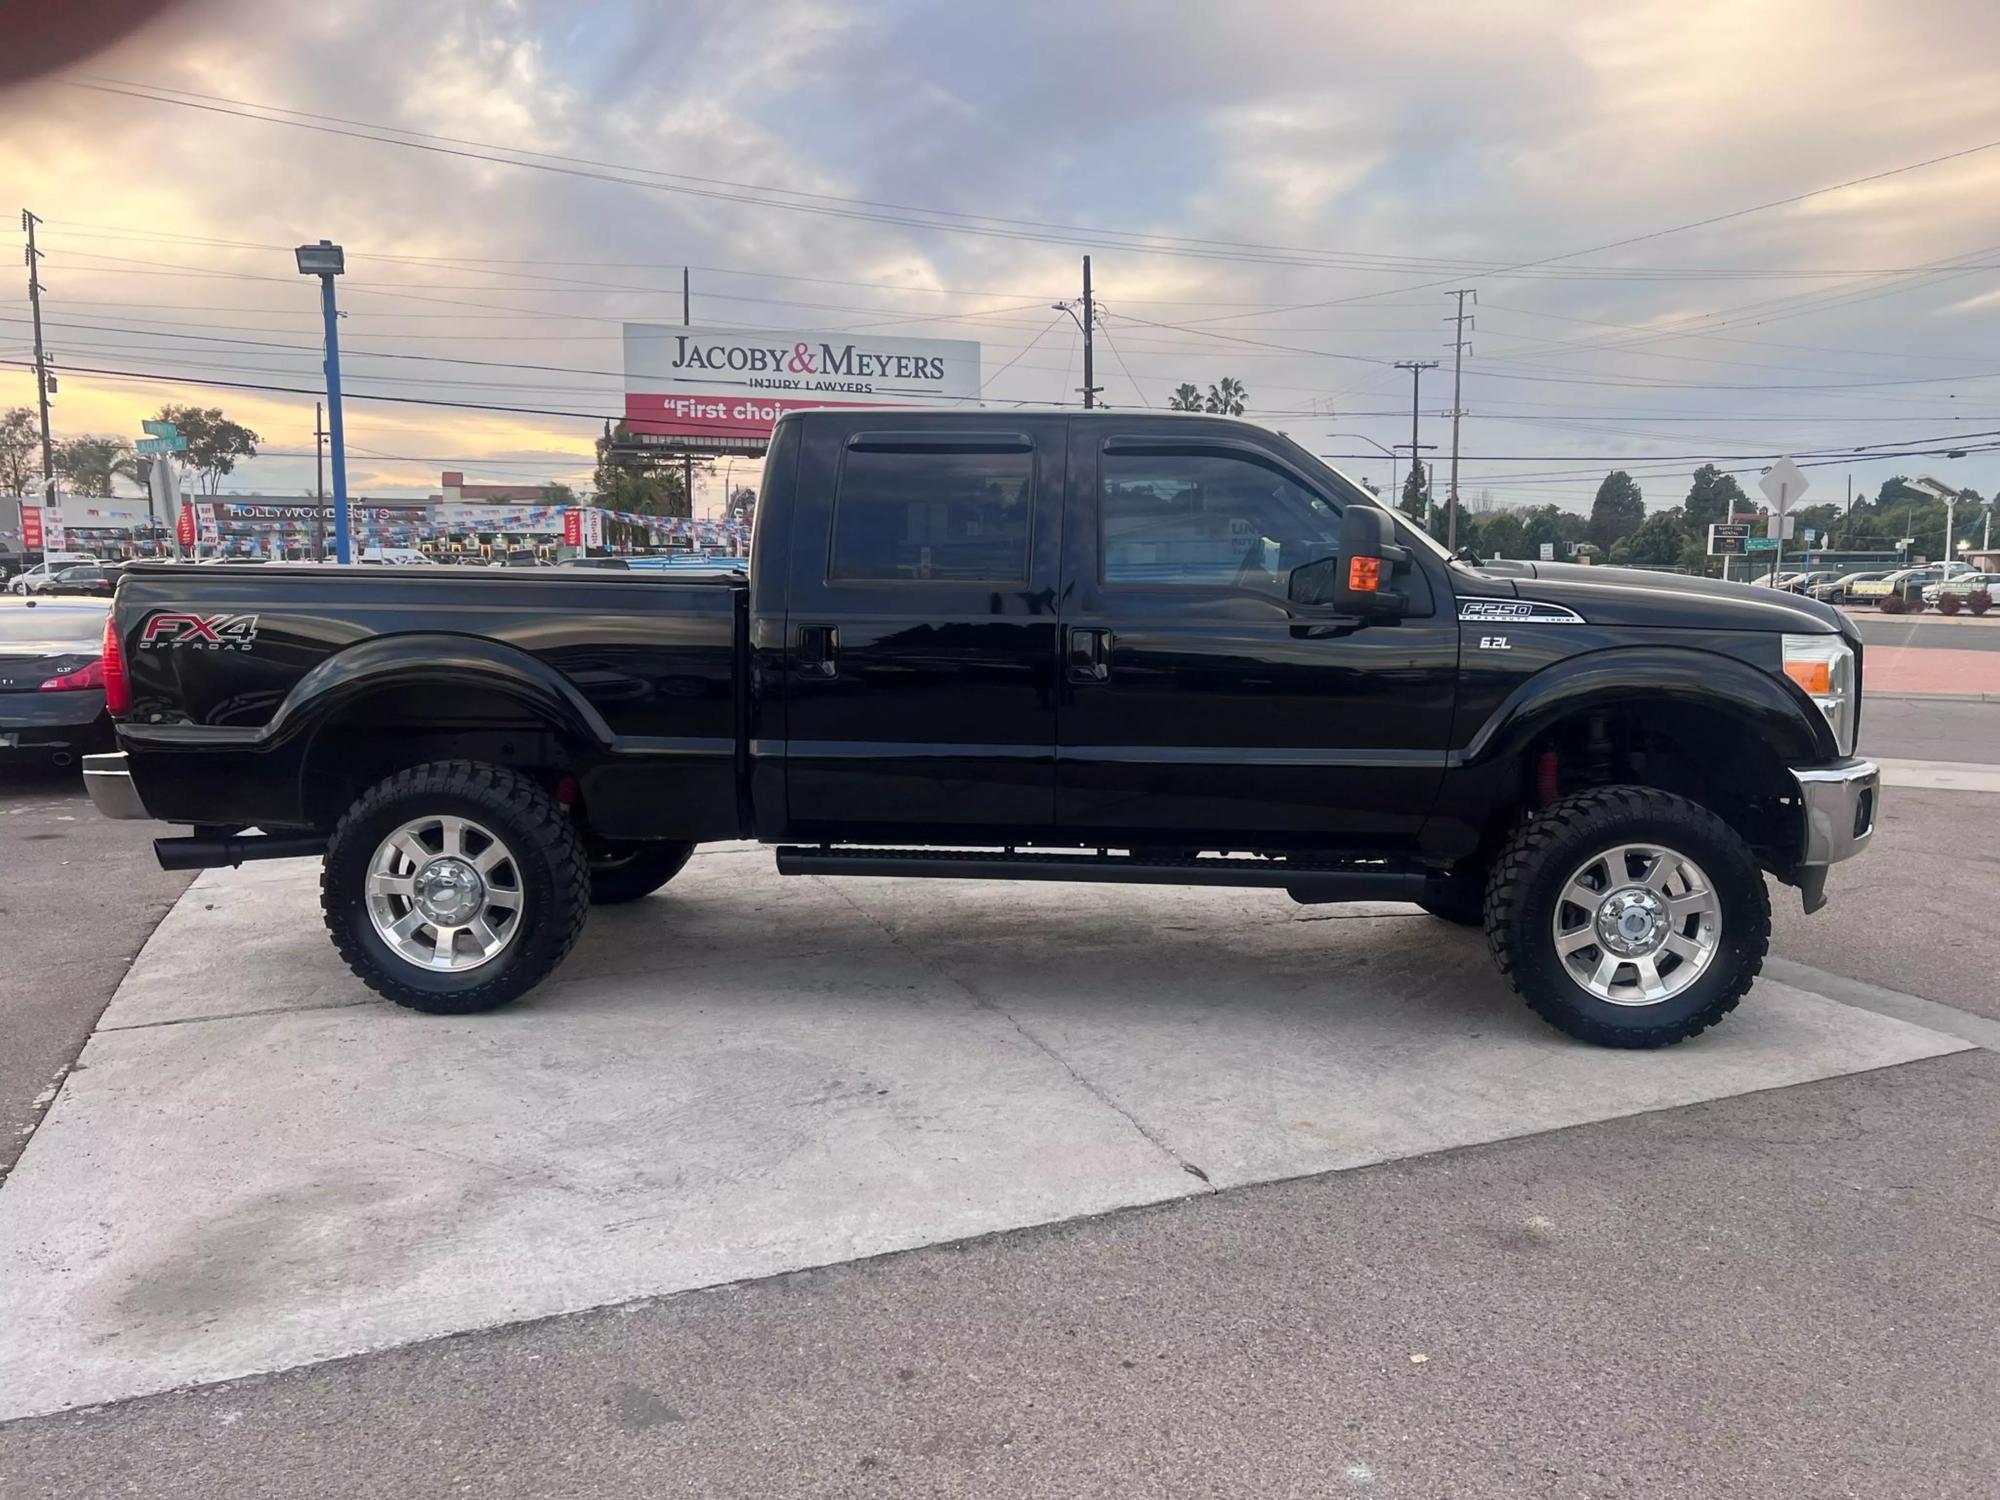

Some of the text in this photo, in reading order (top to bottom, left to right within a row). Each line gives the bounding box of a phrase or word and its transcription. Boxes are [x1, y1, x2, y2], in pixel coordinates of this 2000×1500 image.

[749, 378, 873, 394] INJURY LAWYERS
[140, 613, 260, 644] FX4
[192, 642, 253, 651] ROAD
[1479, 636, 1512, 649] 6.2L
